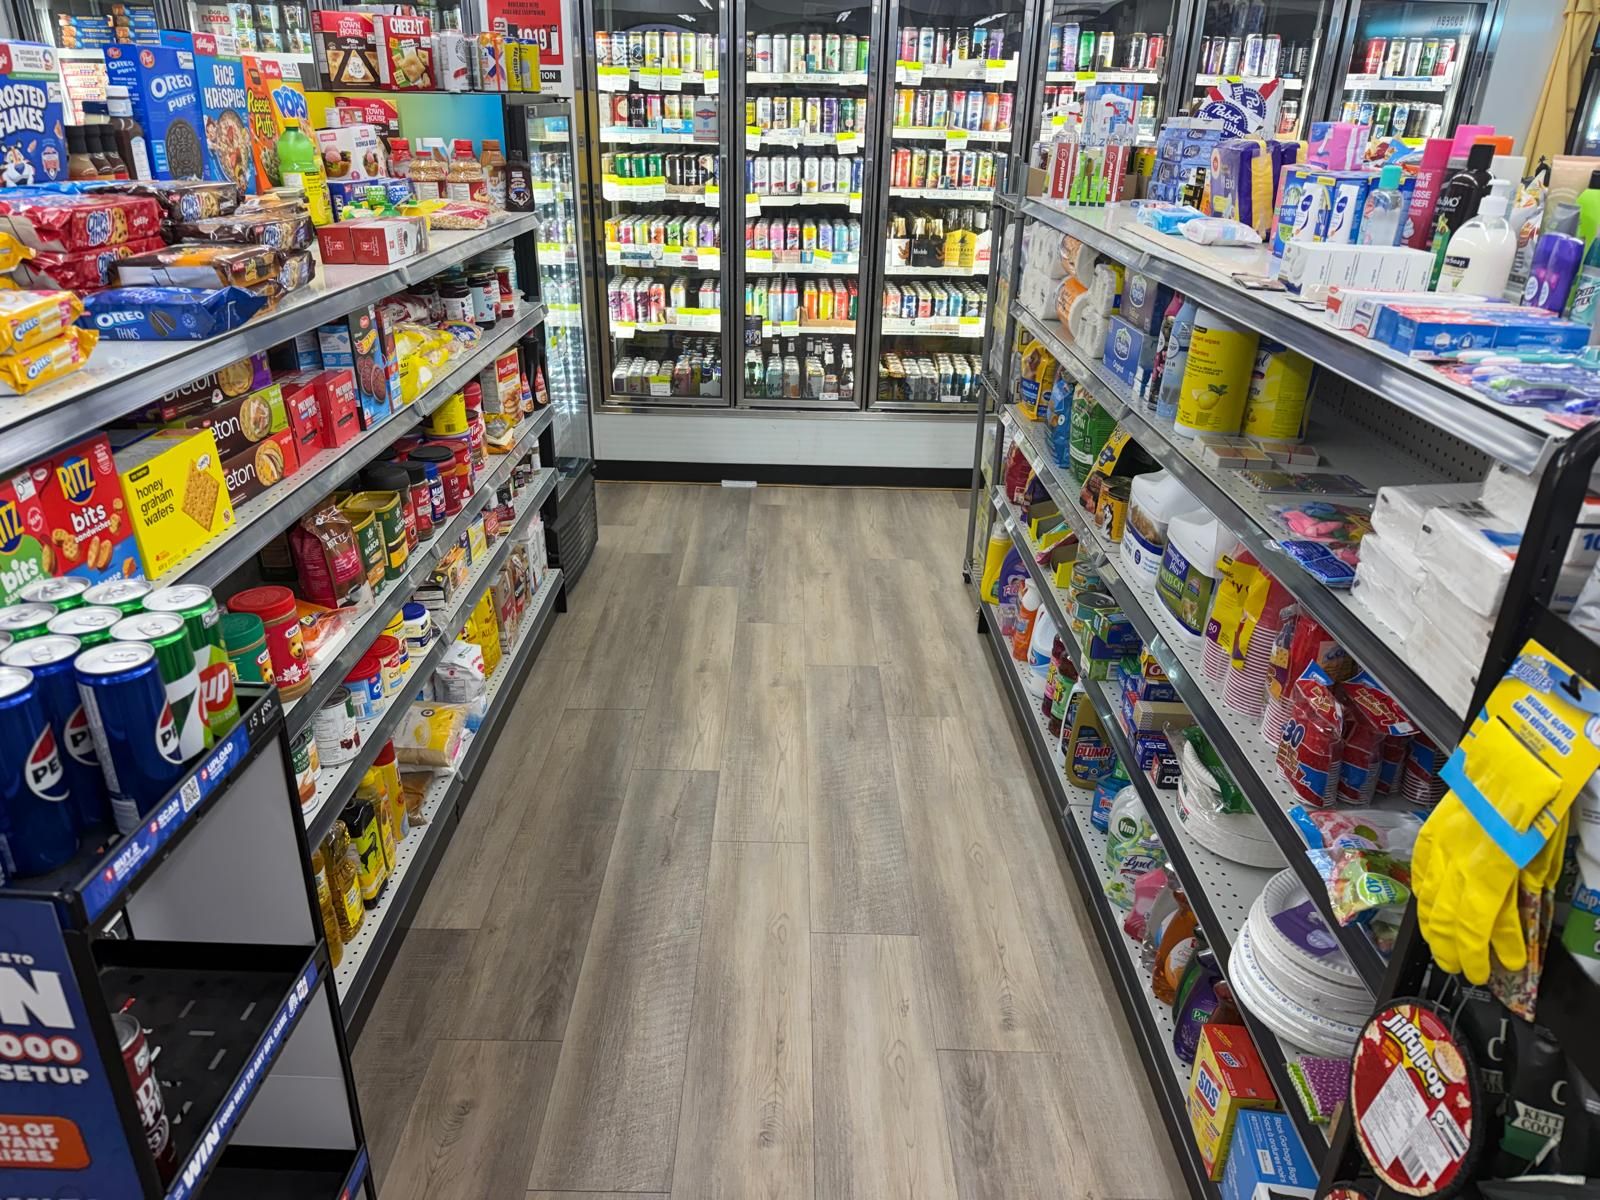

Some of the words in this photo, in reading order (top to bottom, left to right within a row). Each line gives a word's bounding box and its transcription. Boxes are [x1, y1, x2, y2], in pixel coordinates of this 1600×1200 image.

[201, 14, 230, 23] nano
[338, 20, 361, 29] TOWN
[389, 17, 425, 35] CHEEZ-IT
[340, 28, 363, 37] HOUSE
[108, 61, 135, 70] OREO
[540, 71, 556, 81] ION
[0, 84, 47, 111] ROSTED
[151, 74, 193, 99] OREO
[168, 93, 196, 112] PUFFS
[364, 107, 385, 116] TOWN
[1211, 103, 1243, 123] Pabst
[87, 210, 109, 229] Chips
[14, 317, 40, 341] OREO
[96, 310, 145, 328] OREO
[27, 355, 51, 379] OREO
[210, 415, 241, 442] eton
[57, 457, 97, 500] RITZ
[225, 463, 257, 491] eton
[135, 477, 165, 501] honey
[140, 486, 174, 516] graham
[70, 504, 107, 533] bits
[144, 503, 175, 528] wafers
[74, 519, 113, 544] sandwiches
[1, 557, 40, 594] bits
[1208, 622, 1218, 633] 50
[1516, 662, 1554, 690] BUDDIES
[1512, 701, 1532, 720] GANTS
[1283, 718, 1305, 749] 30
[1551, 716, 1577, 741] GLOVES
[206, 741, 234, 774] UPLOAD
[157, 800, 180, 826] SCAN
[1120, 820, 1136, 835] Vim
[113, 847, 133, 870] BUY
[1123, 855, 1156, 870] Lysol
[1366, 876, 1382, 894] 40
[15, 953, 35, 966] TO
[1220, 1051, 1238, 1068] SOS
[1382, 1013, 1424, 1067] Jiffy
[1418, 1053, 1448, 1100] pop
[0, 1066, 89, 1085] SETUP
[1198, 1069, 1220, 1108] SOS
[181, 1120, 222, 1190] WIN
[218, 1100, 236, 1129] YOUR
[232, 1079, 248, 1105] WAY
[251, 1048, 266, 1073] ANY
[262, 1037, 276, 1058] NFL
[271, 1011, 289, 1041] GAME
[1523, 1107, 1561, 1128] KETT
[23, 1123, 55, 1136] OF
[0, 1137, 59, 1150] TANT
[1273, 1116, 1285, 1136] Black
[1280, 1135, 1294, 1166] Garbage
[1287, 1166, 1299, 1185] Bags
[0, 1151, 55, 1163] IZES
[1269, 1138, 1282, 1165] ordures
[1276, 1165, 1287, 1184] noirs
